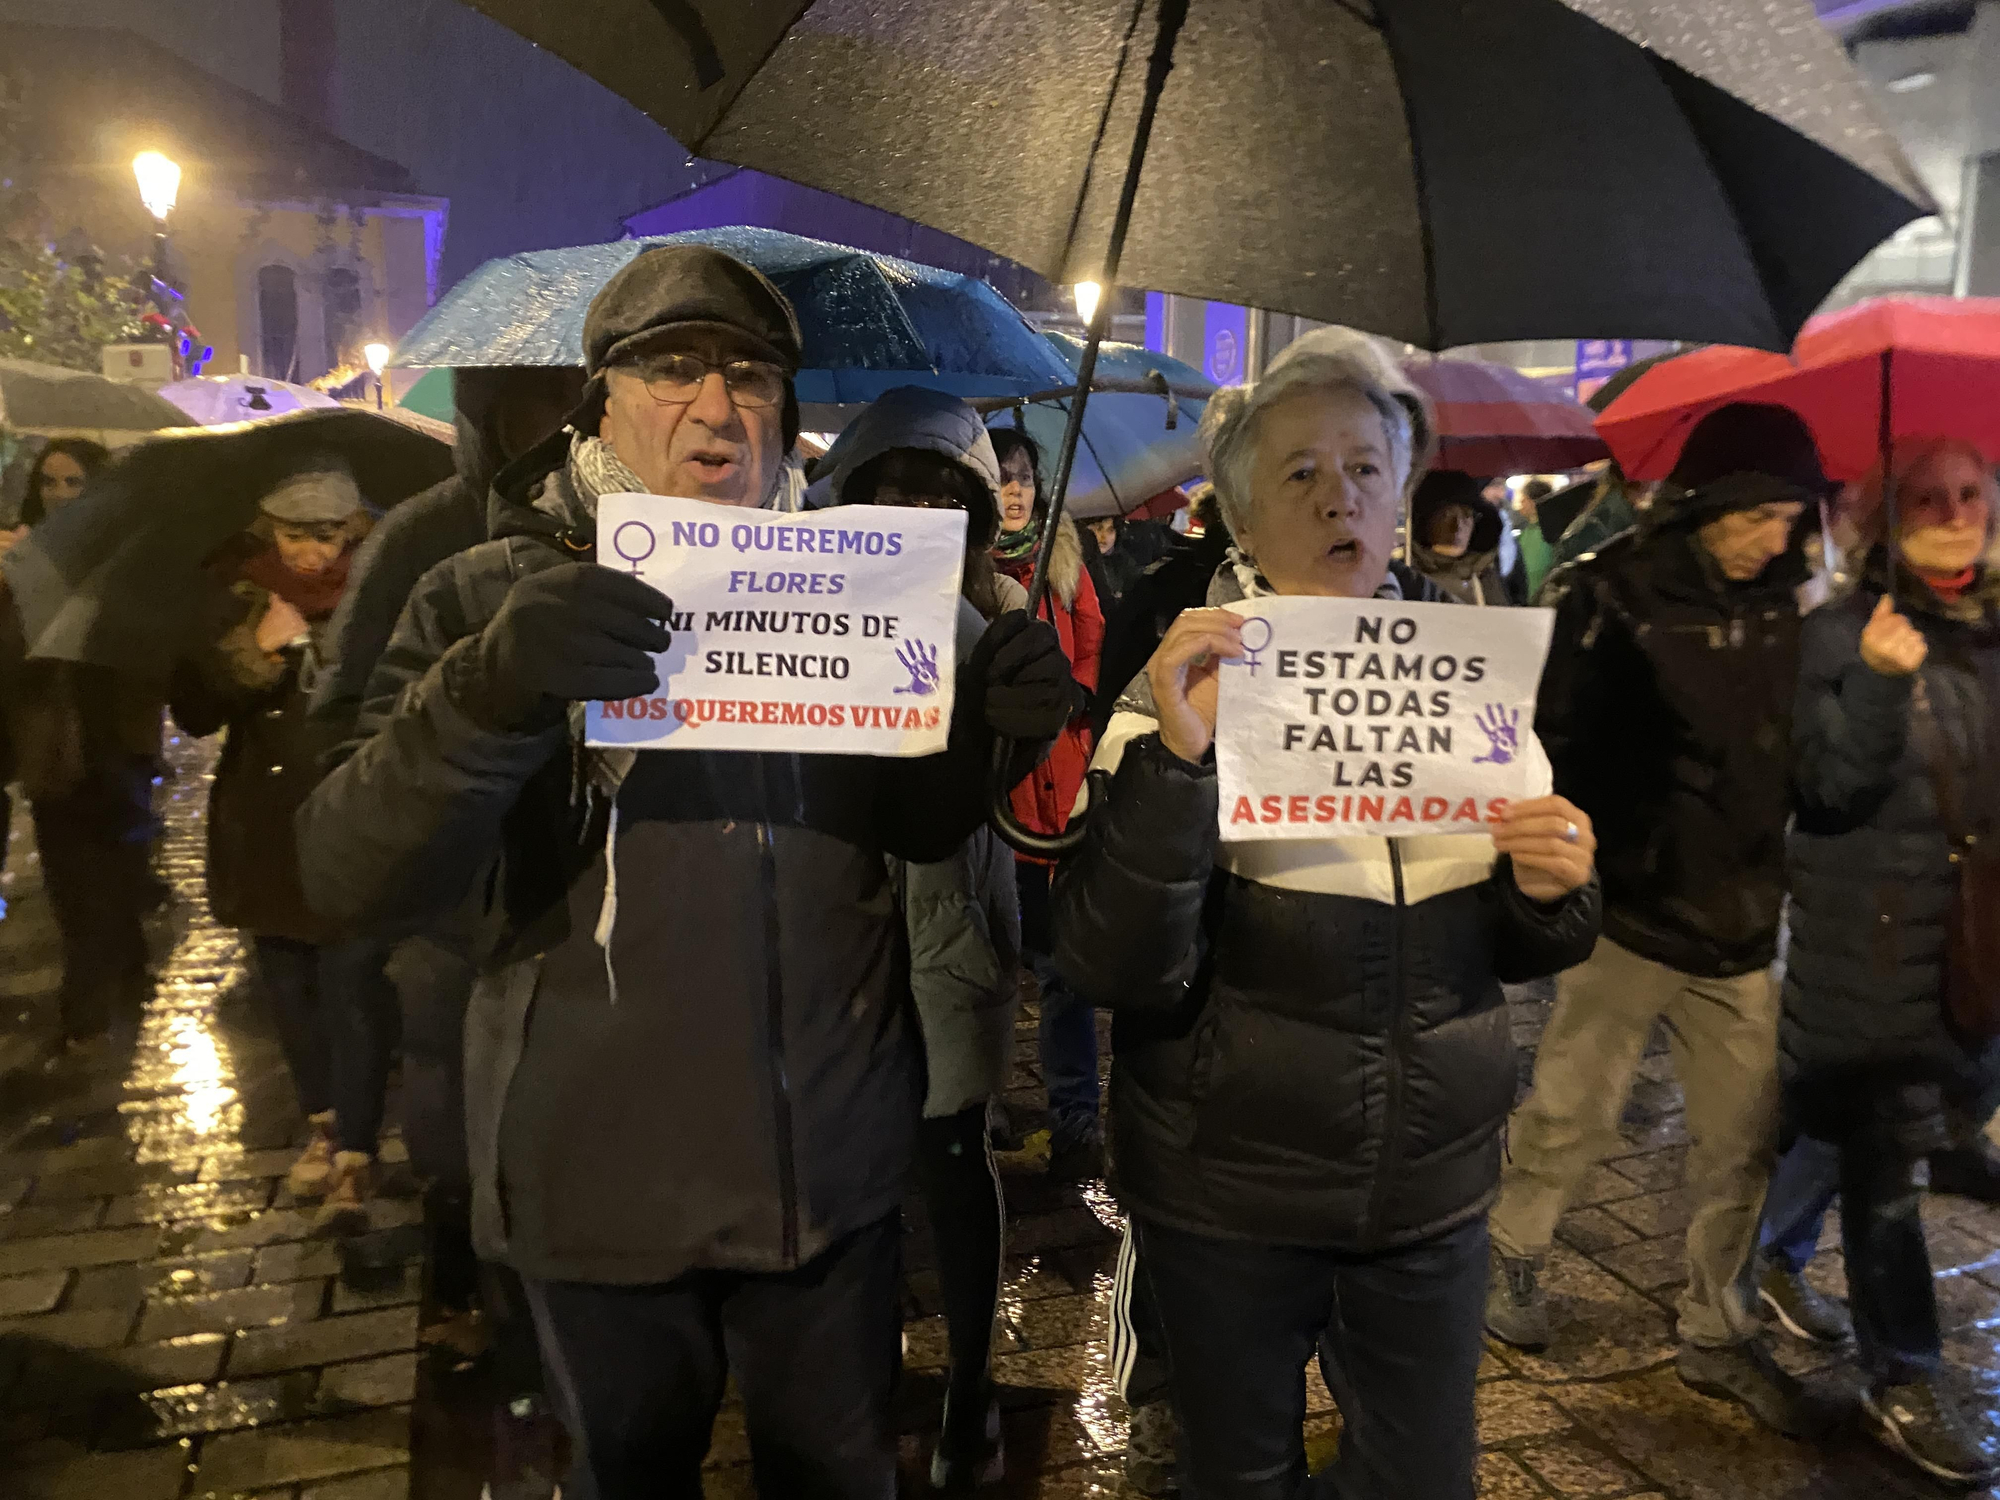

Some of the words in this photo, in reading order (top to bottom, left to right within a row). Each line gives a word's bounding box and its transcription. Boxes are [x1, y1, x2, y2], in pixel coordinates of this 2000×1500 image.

[672, 521, 720, 547] NO
[731, 525, 903, 556] QUEREMOS
[728, 571, 846, 595] FLORES
[705, 611, 850, 637] MINUTOS
[862, 615, 899, 638] DE
[1355, 616, 1417, 645] NO
[705, 651, 850, 679] SILENCIO
[1276, 649, 1486, 682] ESTAMOS
[601, 697, 667, 720] NOS
[673, 699, 845, 729] QUEREMOS
[851, 705, 941, 730] VIVAS
[1304, 688, 1451, 717] TODAS
[1282, 724, 1452, 754] FALTAN
[1333, 761, 1414, 787] LAS
[1231, 795, 1509, 825] ASESINADAS
